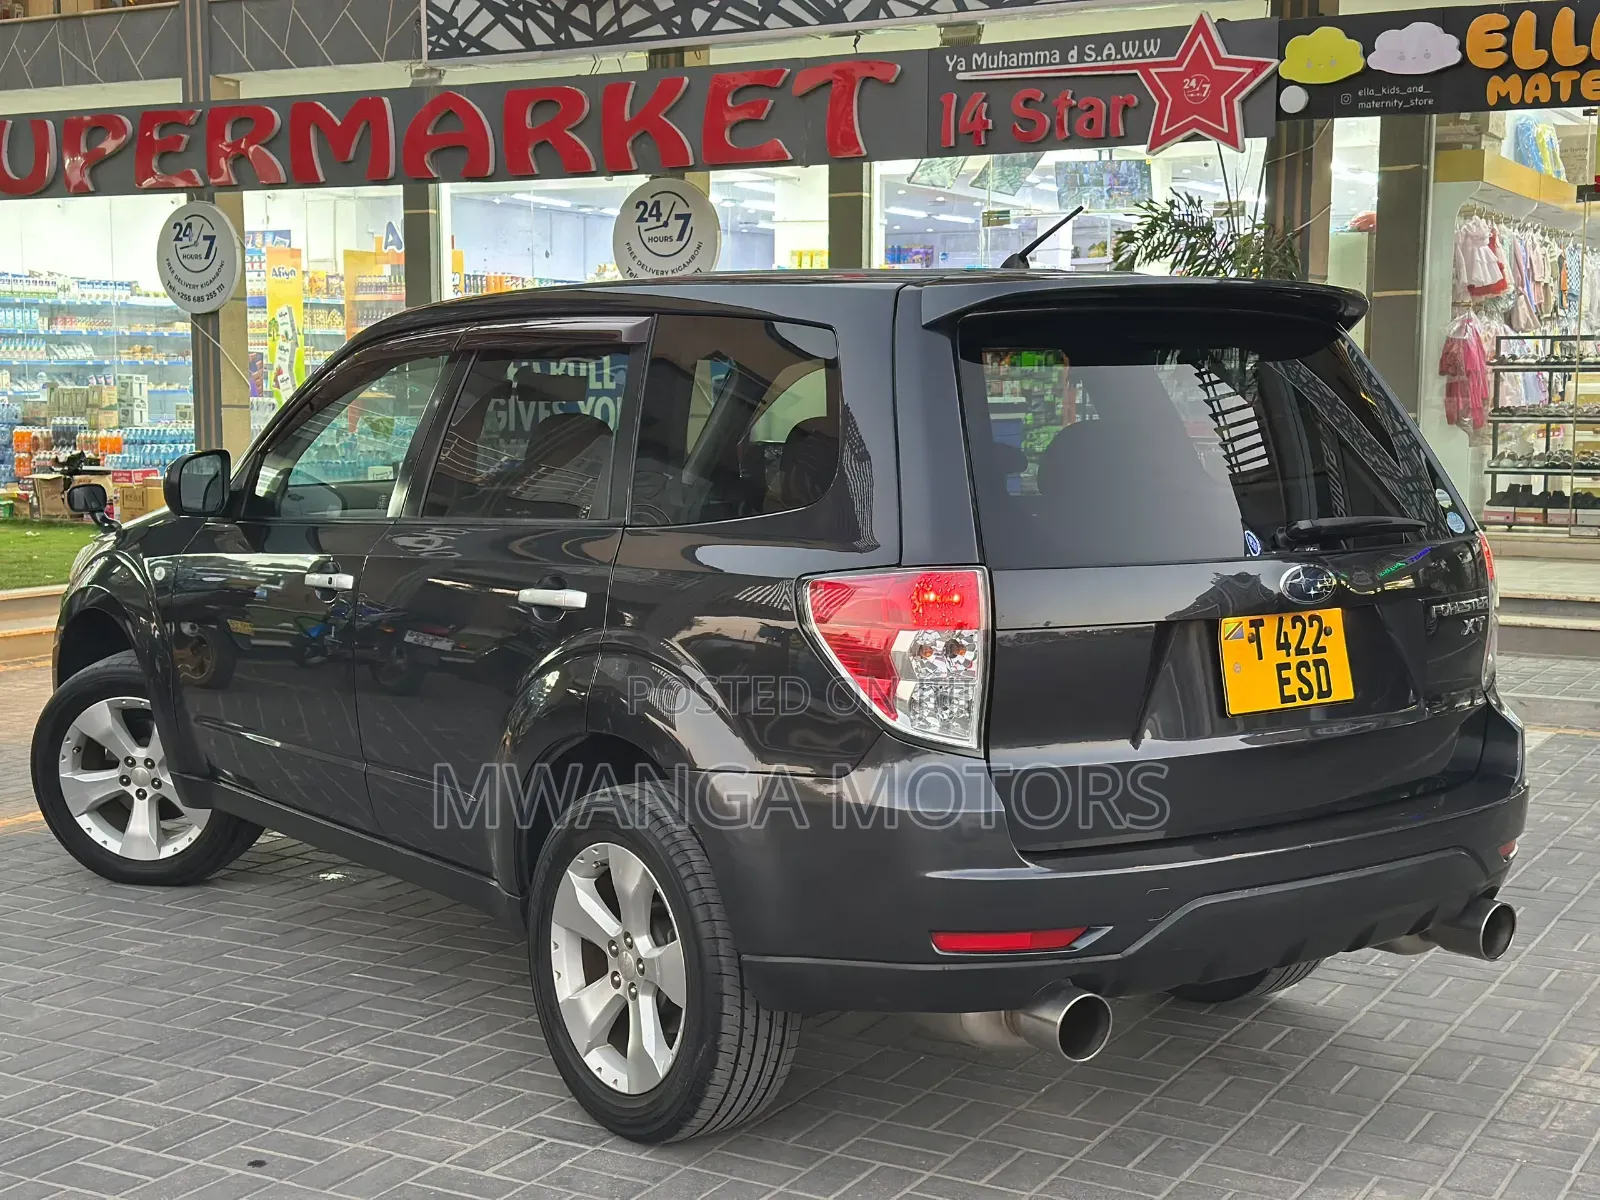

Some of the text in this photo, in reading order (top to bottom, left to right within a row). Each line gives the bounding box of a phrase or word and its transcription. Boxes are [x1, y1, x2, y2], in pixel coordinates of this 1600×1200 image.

[946, 54, 966, 72] Ya
[1084, 38, 1161, 63] S.A.W.W
[1358, 84, 1431, 97] ella_kids_and_
[1358, 97, 1434, 110] maternity_store
[0, 59, 901, 195] UPERMARKET
[939, 88, 1138, 148] 14 Star
[384, 220, 403, 250] A
[648, 235, 673, 243] HOURS
[165, 258, 225, 290] FREE DELIVERY KIGAMBONI
[624, 242, 637, 261] FREE
[637, 260, 669, 276] DELIVERY
[671, 241, 704, 274] KIGAMBONI
[166, 280, 177, 294] Tel:
[177, 291, 191, 303] +255
[192, 295, 205, 303] 685
[205, 290, 218, 301] 255
[1248, 613, 1328, 660] T 422
[1461, 615, 1486, 635] XT
[1276, 658, 1333, 704] ESD
